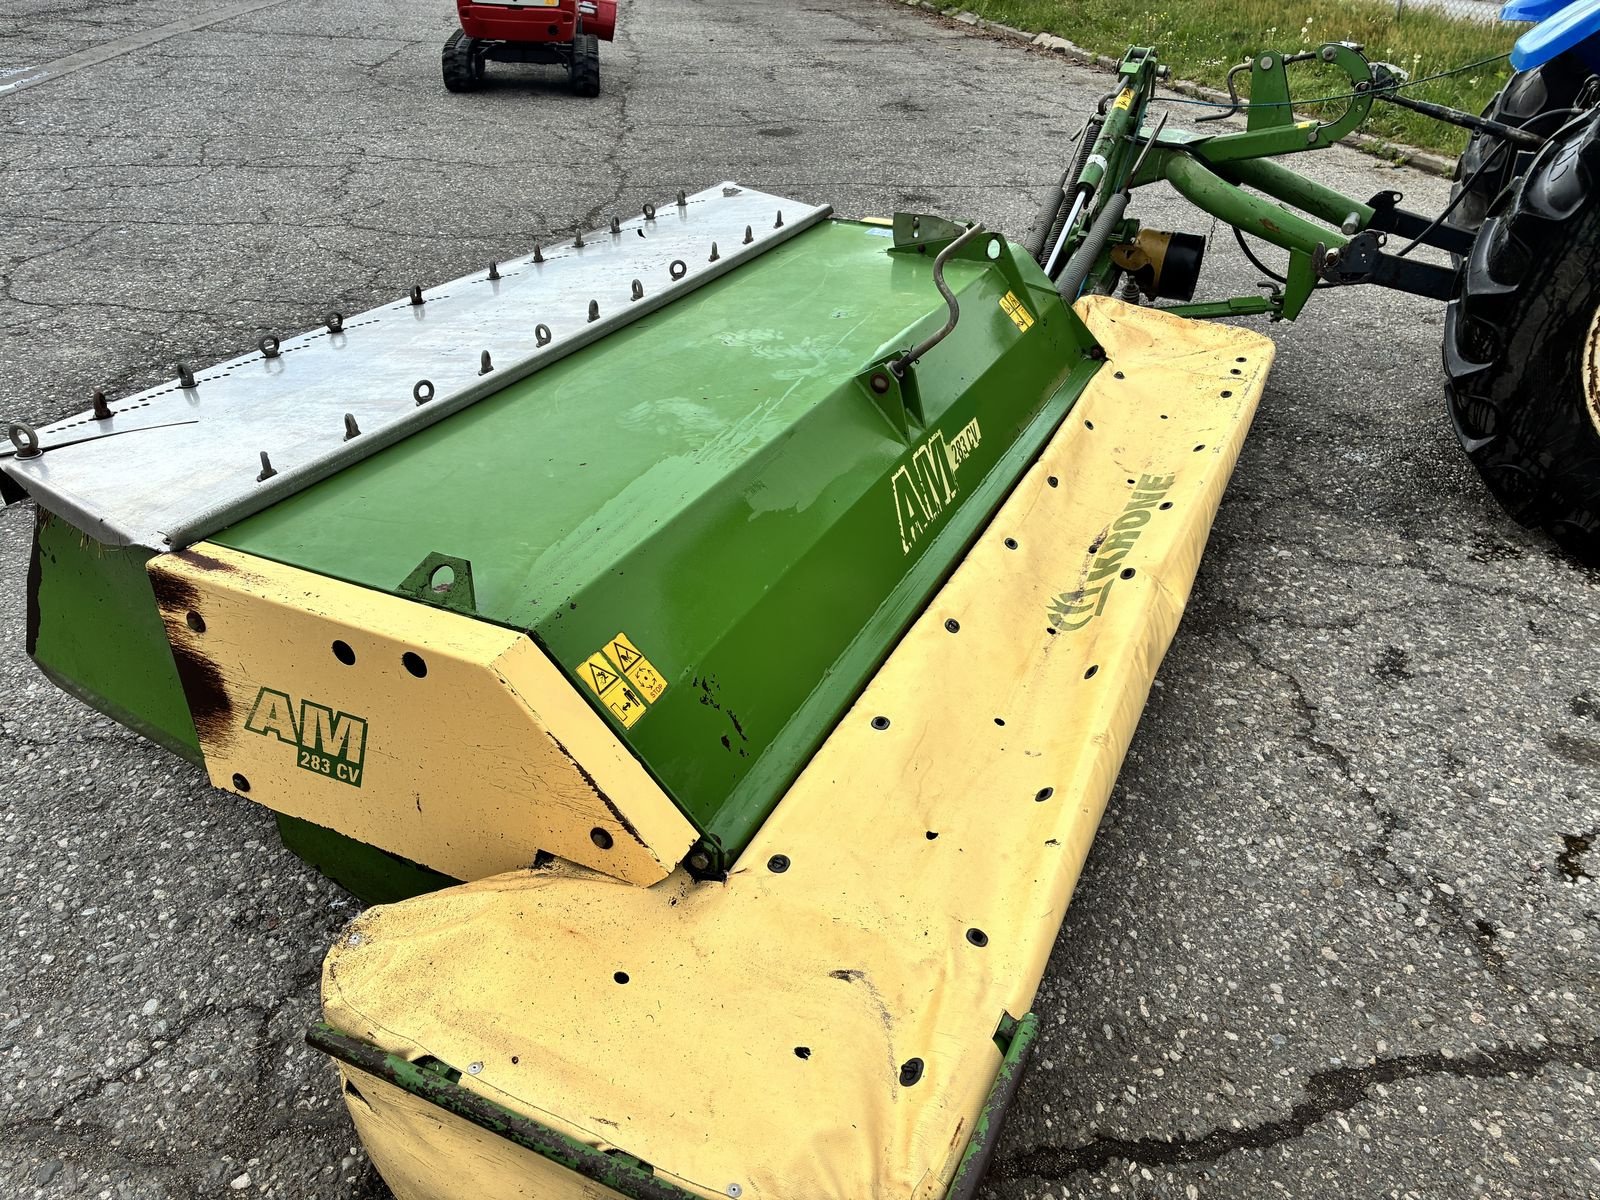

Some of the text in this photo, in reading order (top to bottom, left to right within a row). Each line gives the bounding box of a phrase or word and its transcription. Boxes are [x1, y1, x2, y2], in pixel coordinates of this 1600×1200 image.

[951, 422, 979, 464] 283 CV
[891, 428, 959, 556] AM
[1086, 474, 1176, 582] KRONE
[650, 683, 663, 698] STOP
[244, 686, 368, 766] AM
[300, 751, 360, 783] 283 CV
